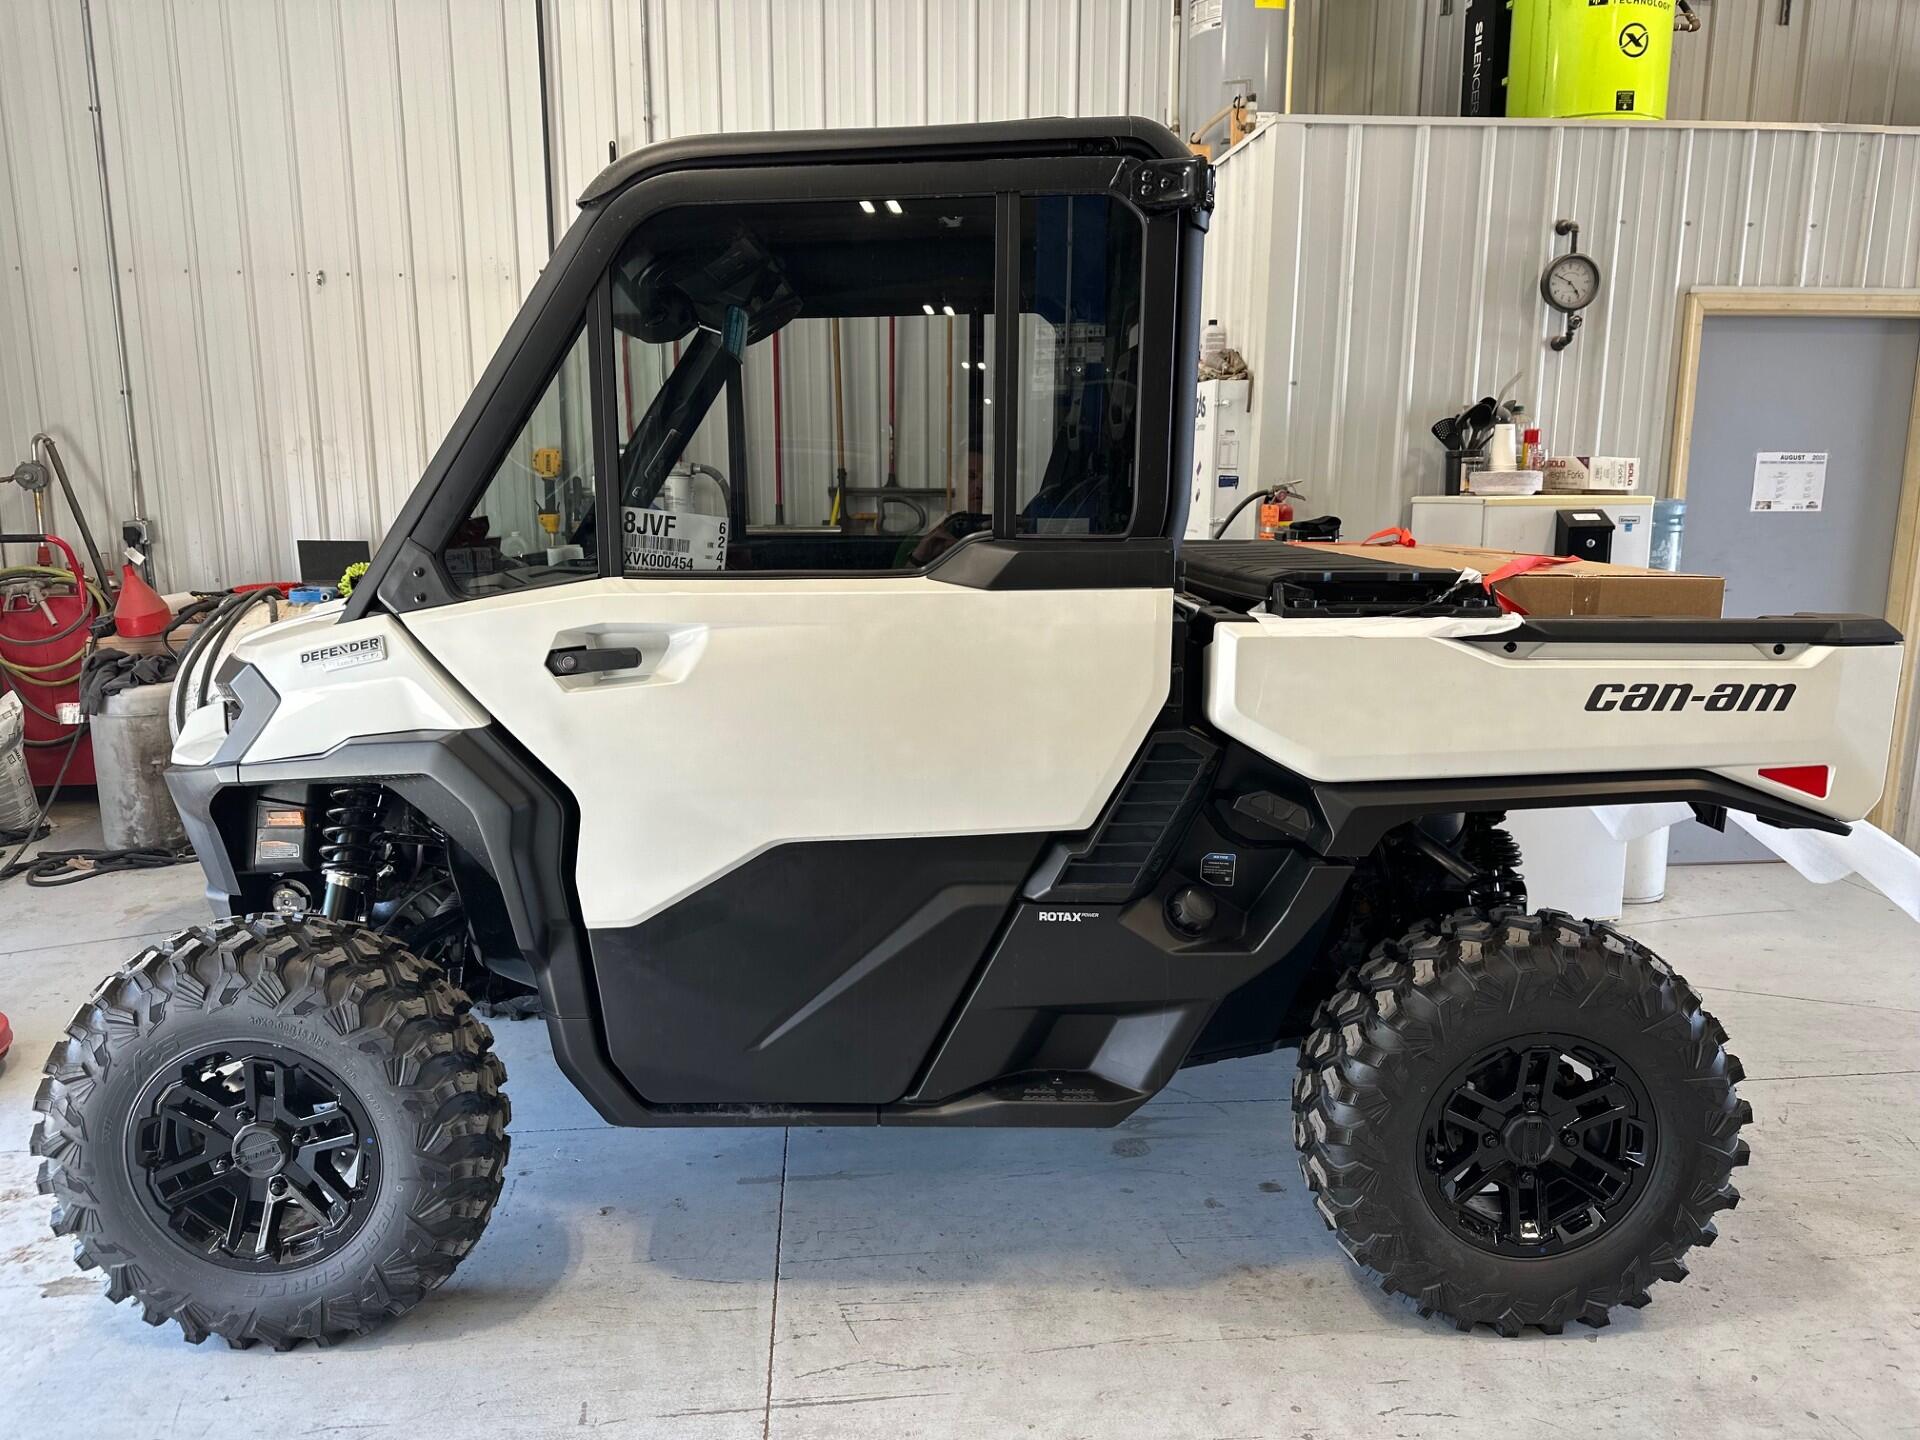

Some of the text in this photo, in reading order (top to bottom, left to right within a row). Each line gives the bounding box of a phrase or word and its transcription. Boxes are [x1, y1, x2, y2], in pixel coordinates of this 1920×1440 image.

[1471, 21, 1484, 116] SILENCER
[1627, 462, 1635, 486] SOLO
[623, 511, 677, 537] 8JVF
[624, 551, 694, 571] XVK000454
[301, 638, 379, 663] DEFENDER
[1584, 683, 1797, 712] can-am
[1039, 911, 1081, 922] ROTAX
